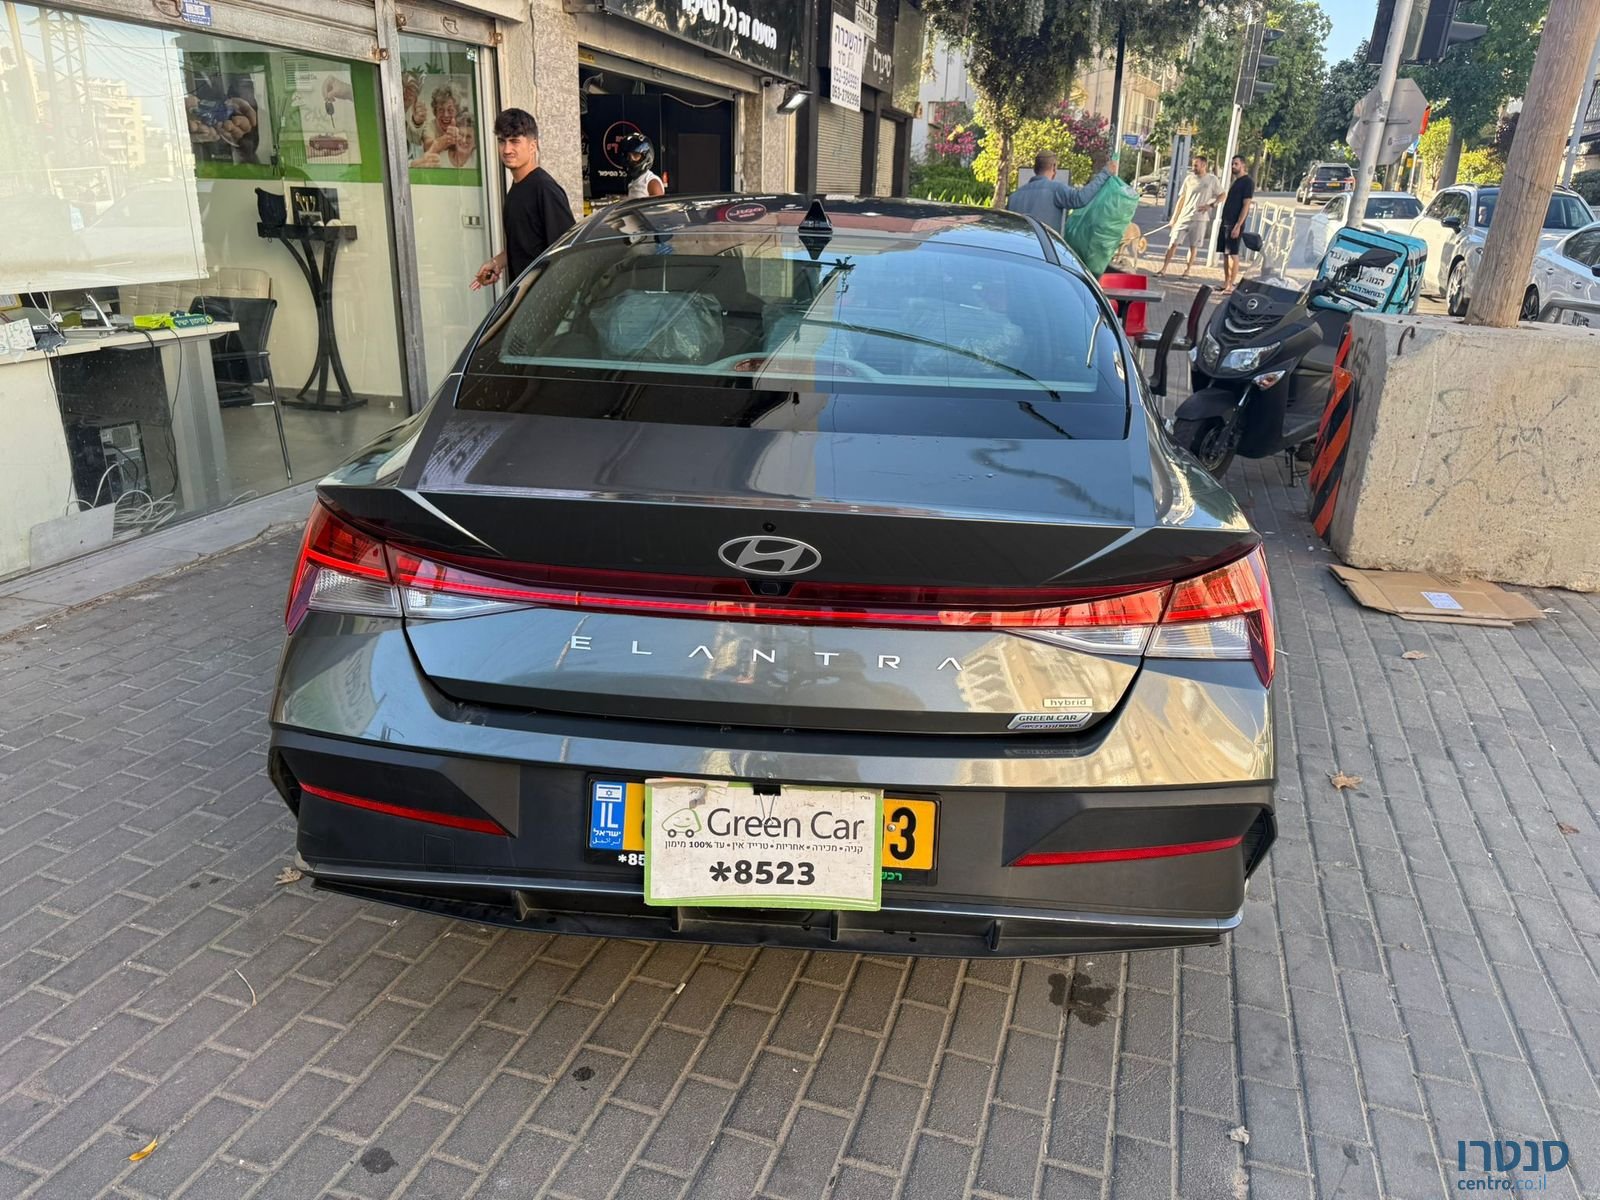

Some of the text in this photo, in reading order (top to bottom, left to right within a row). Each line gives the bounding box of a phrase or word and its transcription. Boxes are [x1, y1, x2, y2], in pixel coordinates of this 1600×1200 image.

[834, 25, 862, 55] להשכרה
[570, 635, 964, 671] ELANTRA
[1050, 698, 1087, 706] hybrid
[1018, 714, 1054, 722] GREEN
[600, 802, 619, 828] IL
[706, 807, 865, 841] Green Car
[592, 828, 622, 837] ישראל
[664, 840, 863, 855] קניה מכירה אחריות טרייד אין עד 100% מימון
